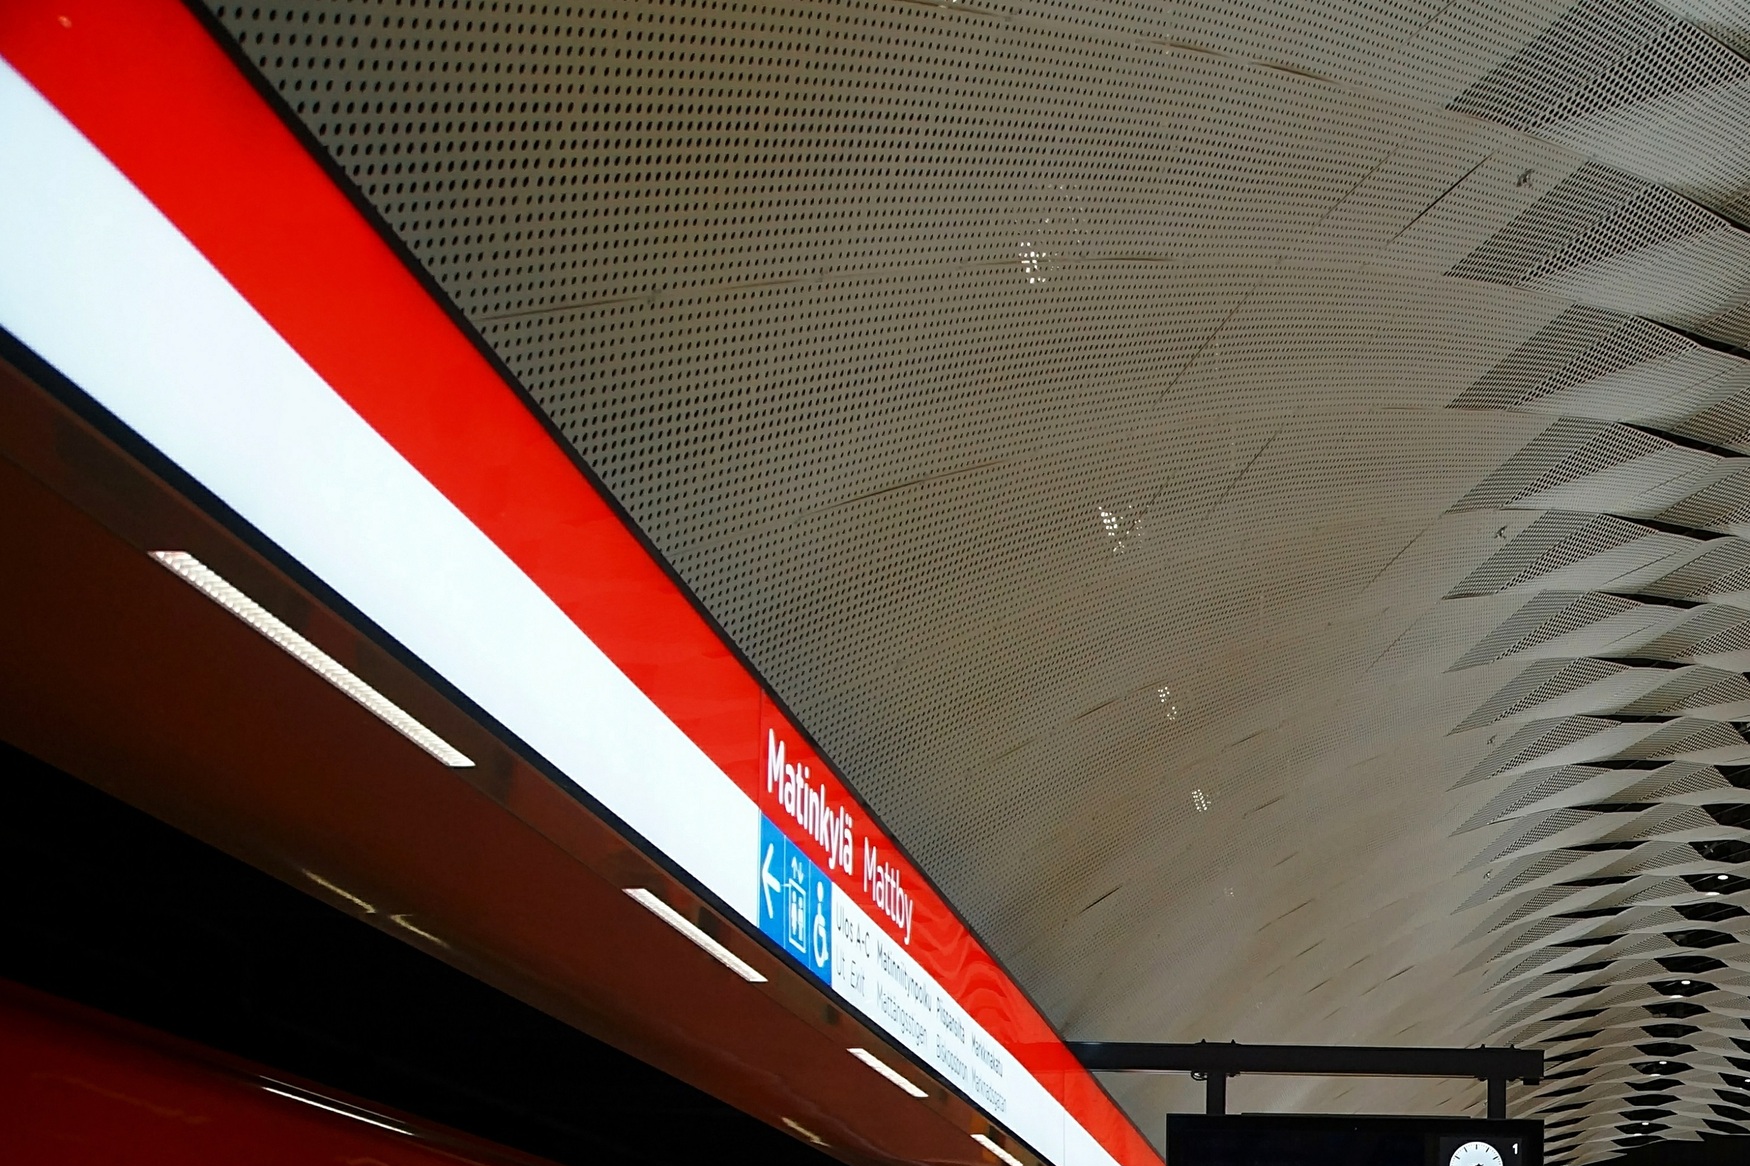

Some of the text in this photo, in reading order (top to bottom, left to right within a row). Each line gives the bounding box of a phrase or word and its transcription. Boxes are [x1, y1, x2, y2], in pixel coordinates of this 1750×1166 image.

[767, 728, 913, 946] Matinkylä Mattby
[836, 900, 853, 943] Ulos
[856, 922, 870, 959] A-C
[836, 944, 845, 980] Ut
[850, 959, 865, 998] Exit
[1512, 1142, 1519, 1155] 1
